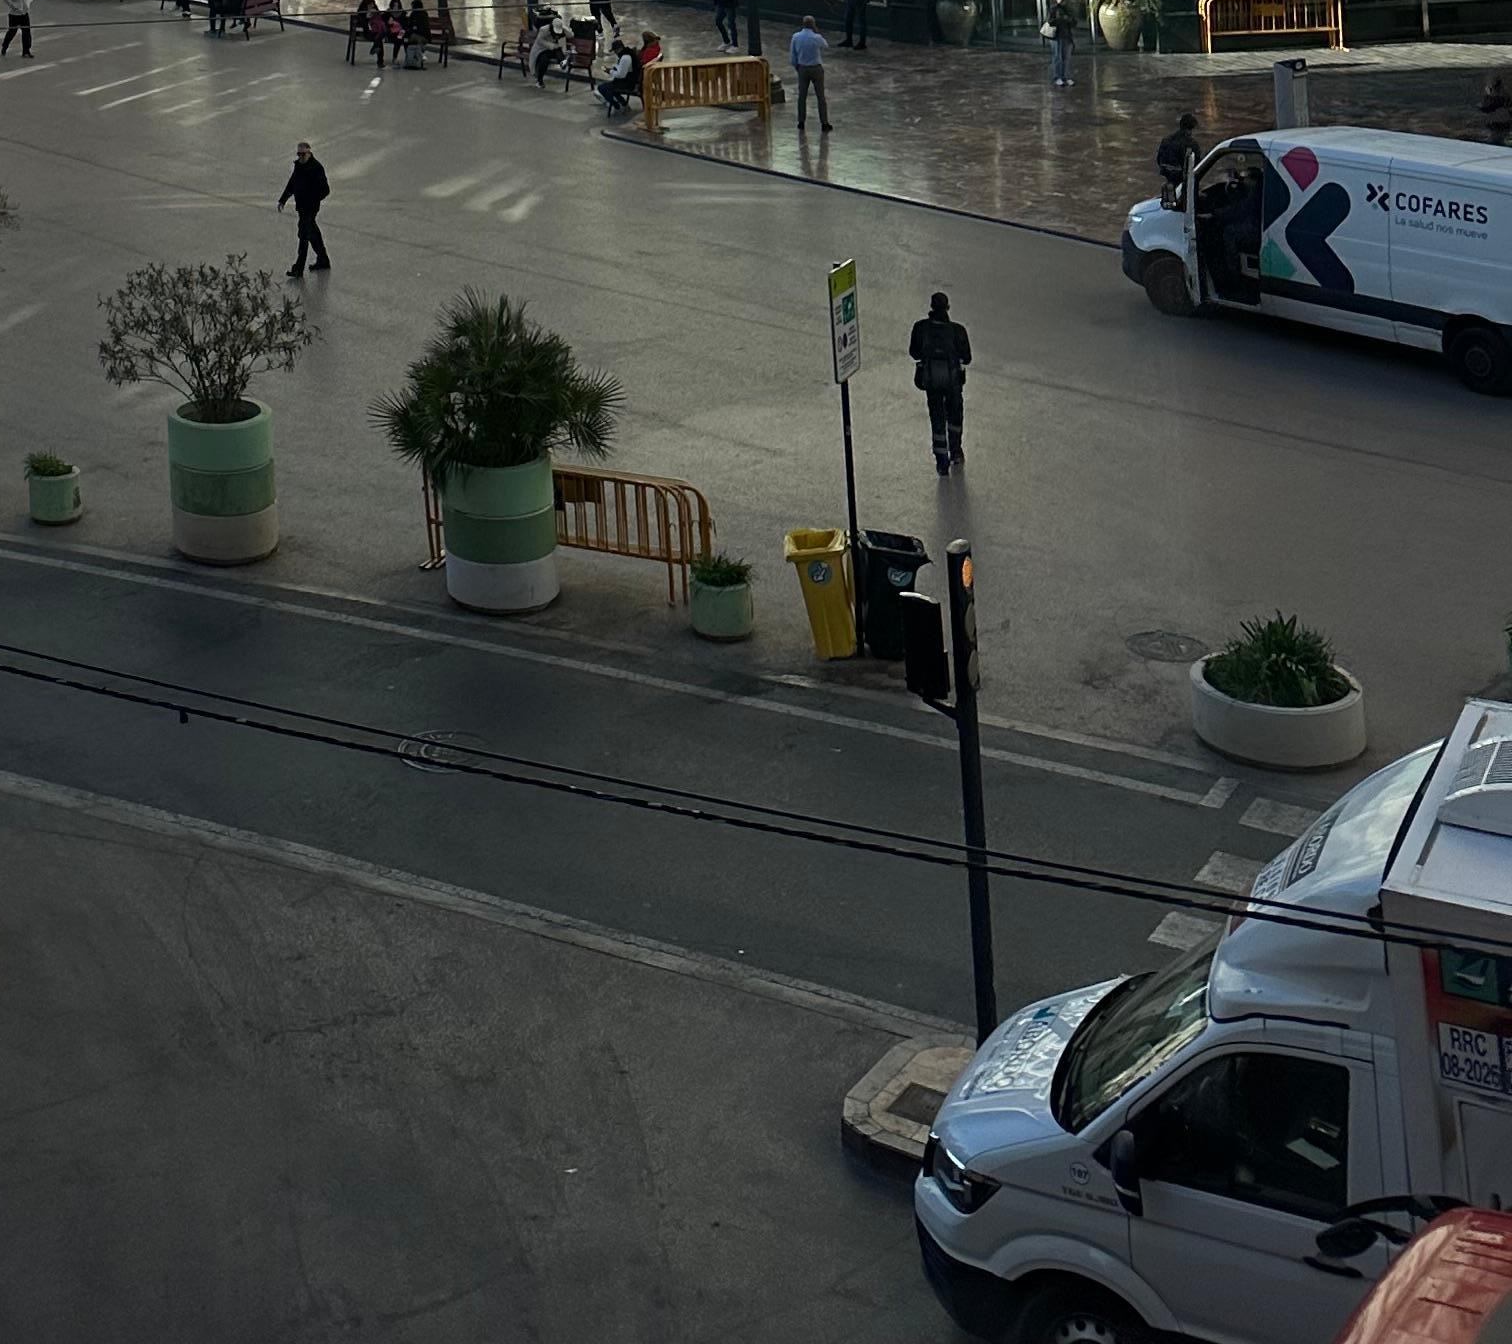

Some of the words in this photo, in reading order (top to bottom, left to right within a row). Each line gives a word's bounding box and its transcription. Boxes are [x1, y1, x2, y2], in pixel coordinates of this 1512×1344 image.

[1395, 192, 1488, 224] COFARES
[1395, 215, 1406, 225] La
[1408, 218, 1434, 231] salud
[1436, 224, 1454, 234] nos
[1455, 228, 1488, 240] mueve
[1449, 1027, 1488, 1057] RRC
